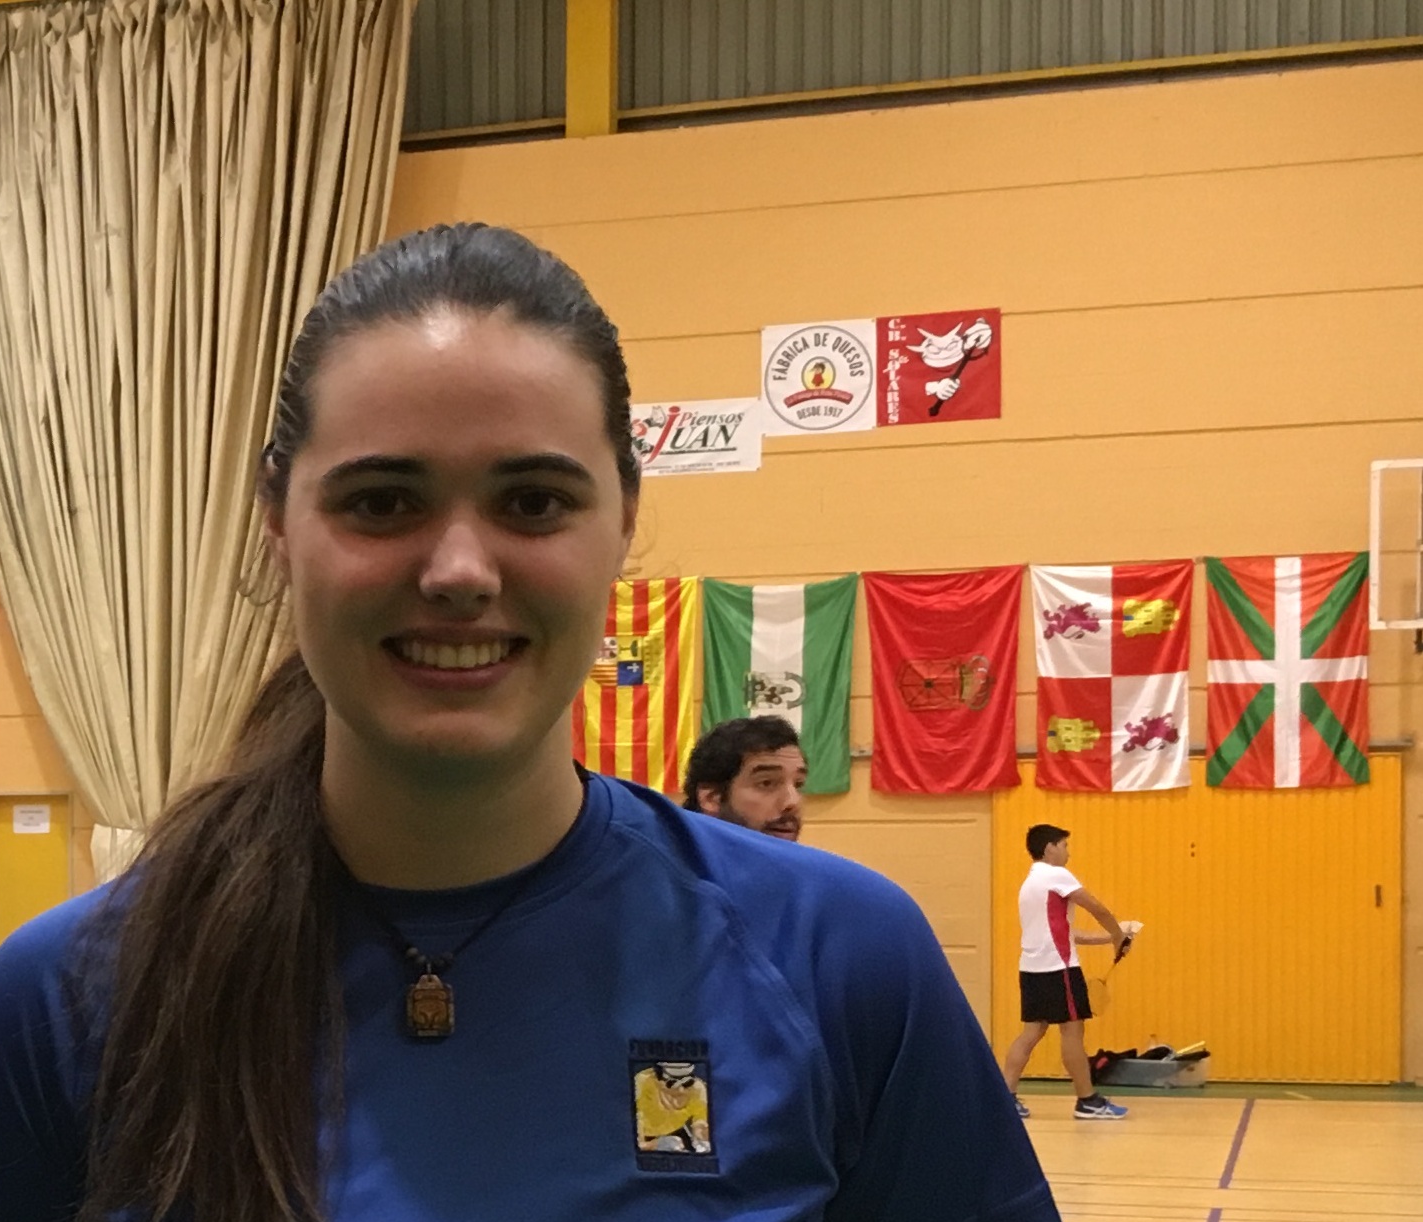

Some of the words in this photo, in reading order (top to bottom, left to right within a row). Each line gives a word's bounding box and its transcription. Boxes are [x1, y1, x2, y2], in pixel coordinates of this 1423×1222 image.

[813, 332, 829, 347] DE
[831, 336, 865, 377] QUESOS
[678, 411, 745, 427] Piensos
[796, 405, 821, 420] DESDE
[823, 405, 843, 418] 1917
